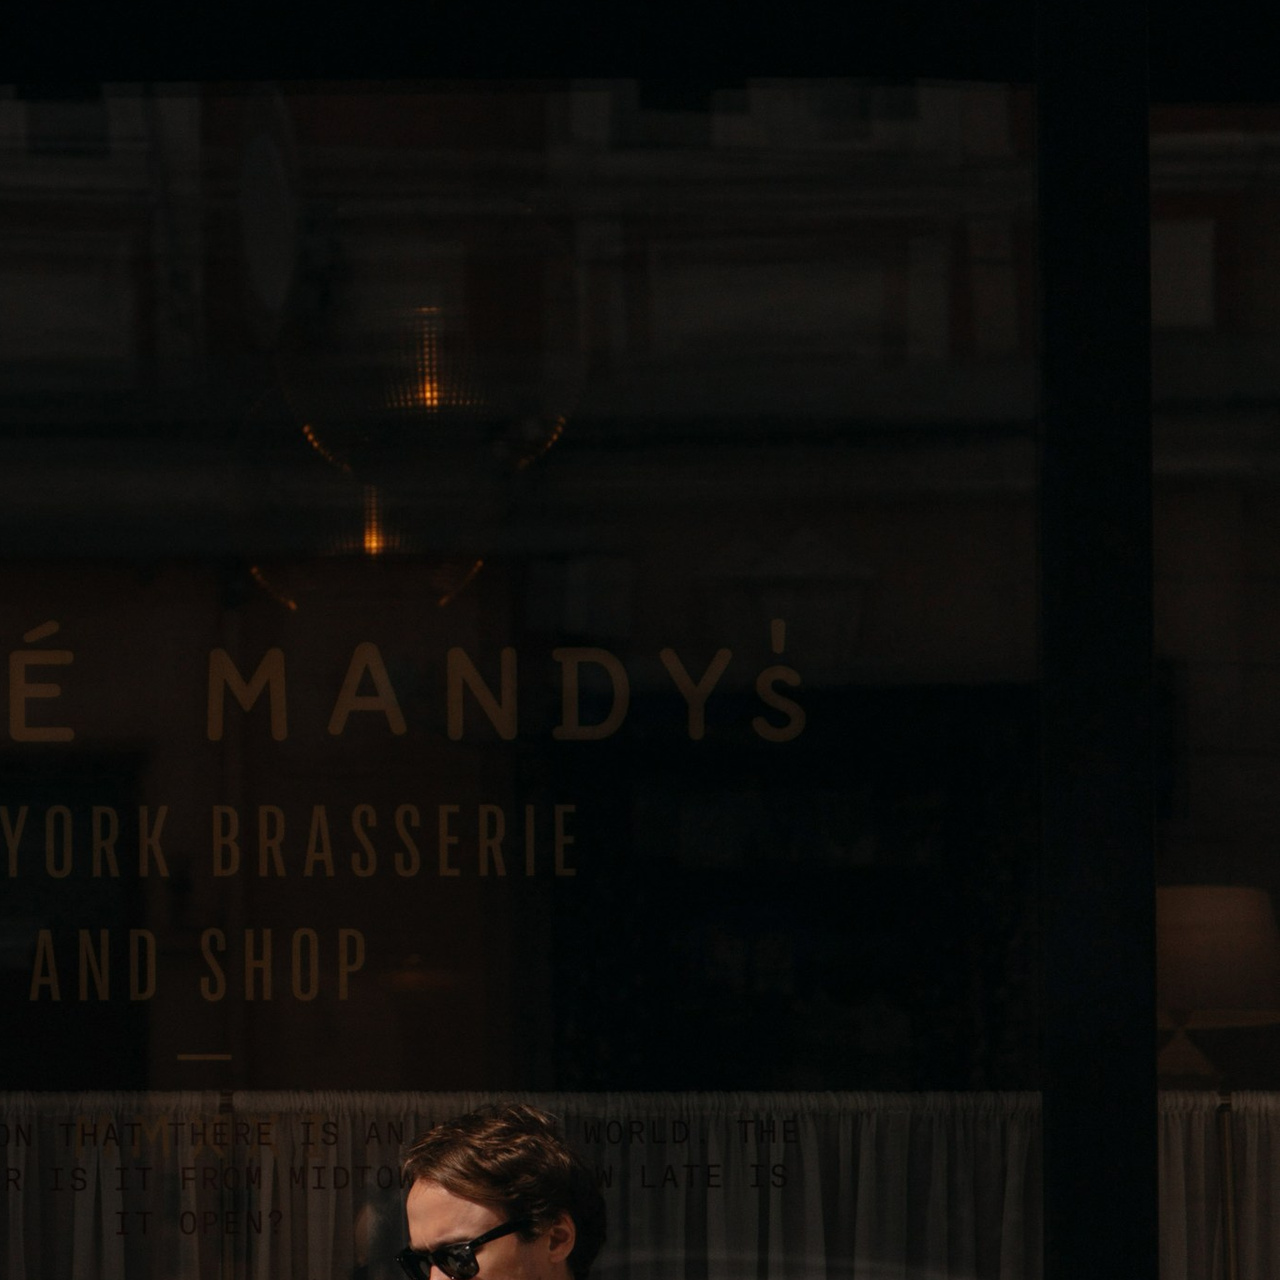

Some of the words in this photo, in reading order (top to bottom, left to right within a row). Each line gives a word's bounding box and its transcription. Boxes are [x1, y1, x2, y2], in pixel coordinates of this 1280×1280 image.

[0, 804, 172, 878] YORK
[213, 803, 579, 877] BRASSERIE
[29, 929, 158, 1001] AND
[200, 928, 368, 1002] SHOP
[59, 1122, 143, 1148] THAT
[168, 1121, 272, 1147] THERE
[301, 1121, 339, 1146] IS
[365, 1121, 404, 1146] AN
[583, 1119, 706, 1145] WORLD.
[738, 1119, 799, 1145] THE
[50, 1166, 88, 1192] IS
[115, 1166, 152, 1191] IT
[181, 1166, 262, 1191] FROM
[641, 1163, 723, 1189] LATE
[750, 1163, 789, 1189] IS
[115, 1210, 153, 1236] IT
[179, 1209, 284, 1236] OPEN?
